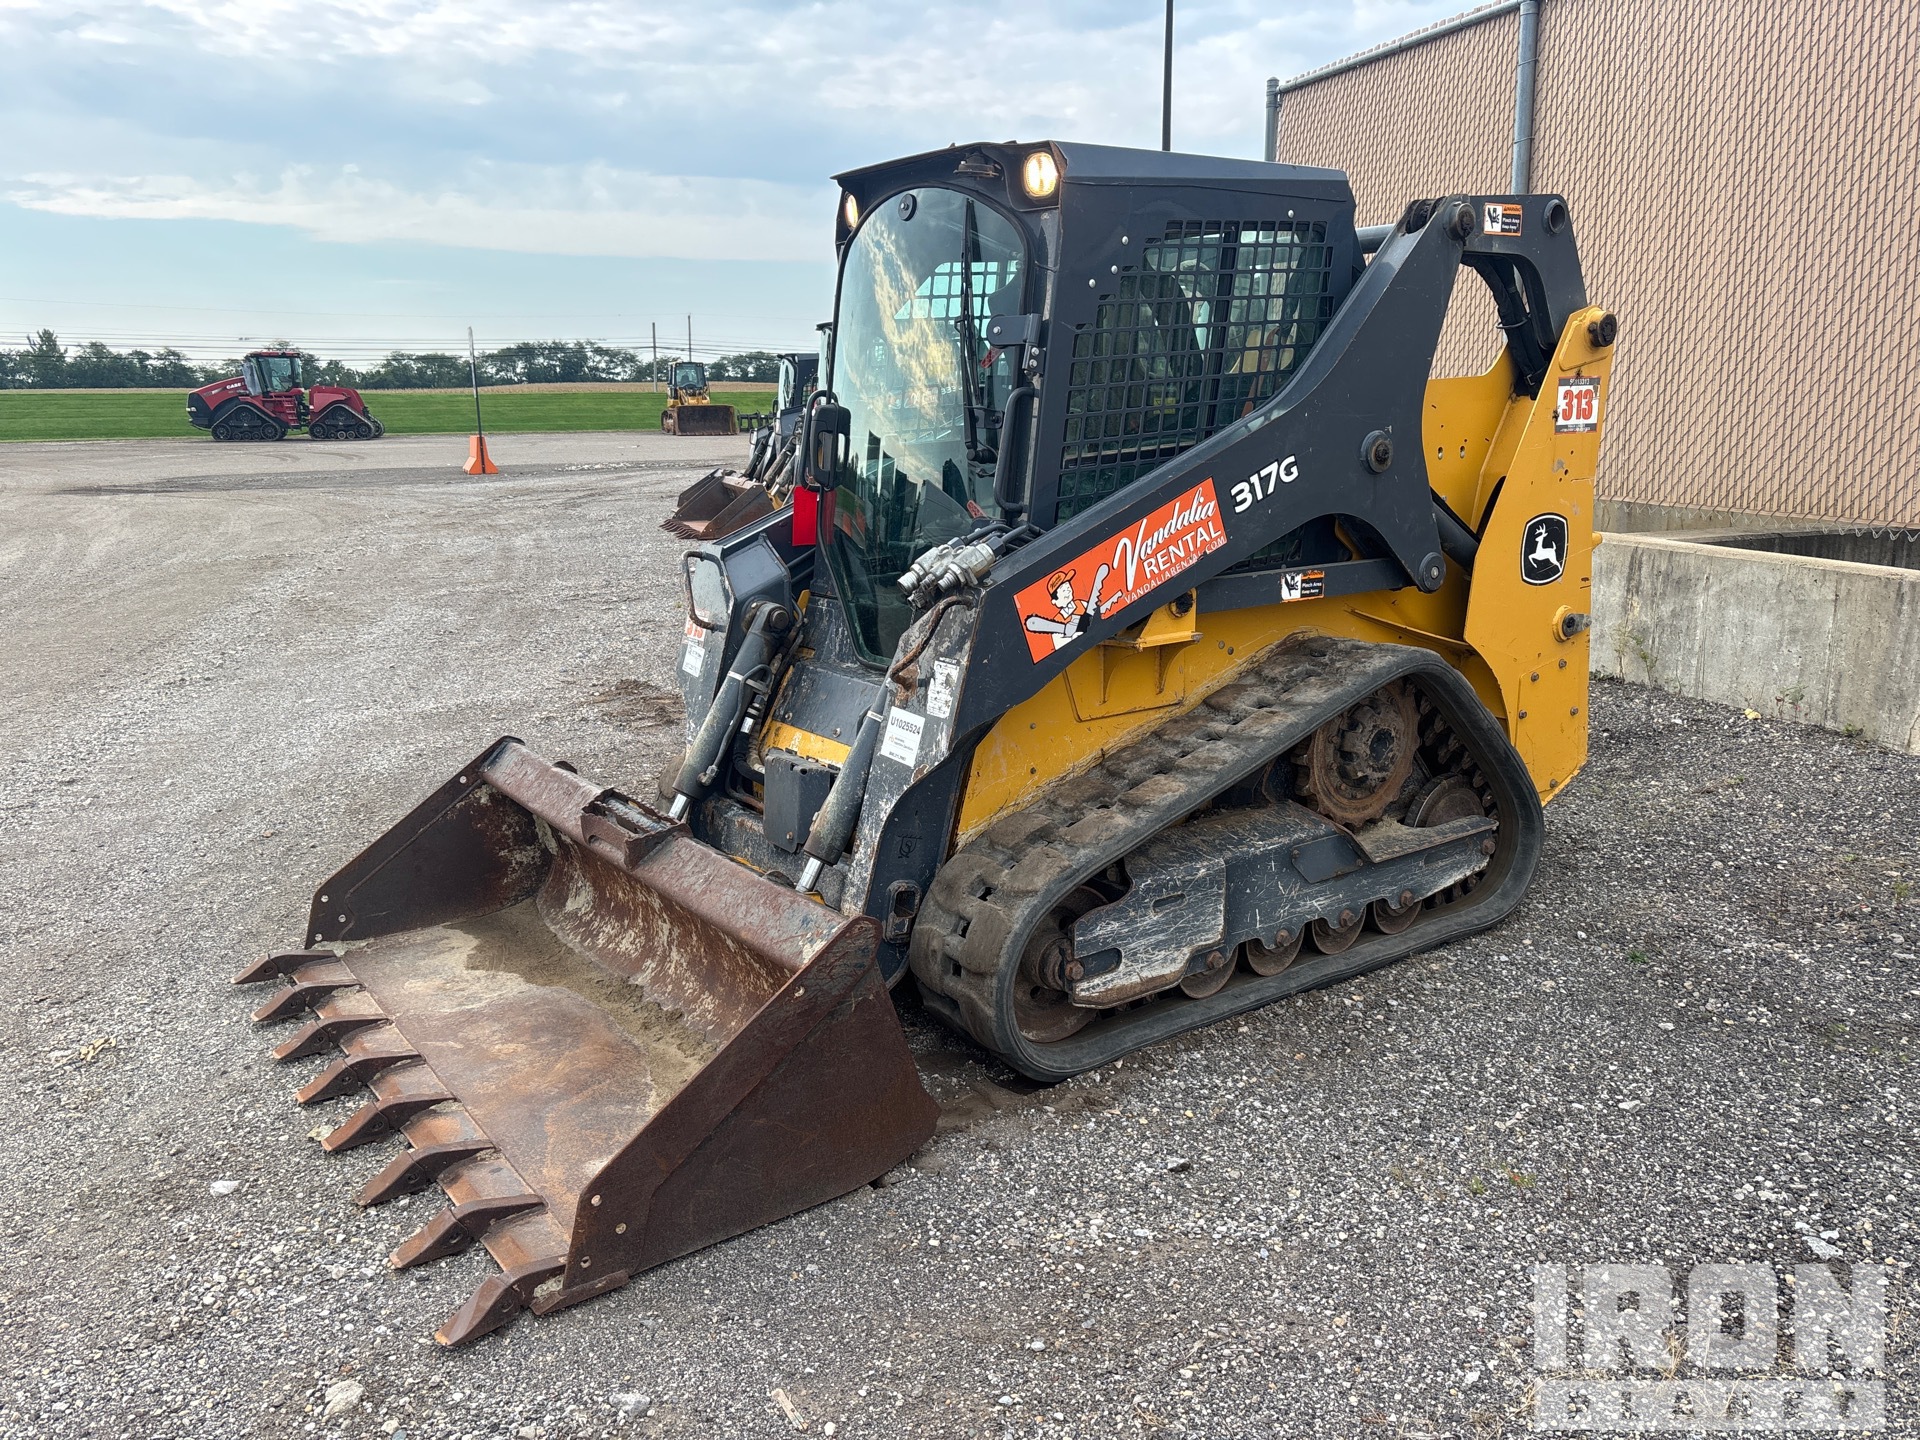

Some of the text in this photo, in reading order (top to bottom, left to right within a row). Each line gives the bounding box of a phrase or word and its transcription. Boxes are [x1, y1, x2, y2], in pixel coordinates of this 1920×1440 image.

[1561, 388, 1594, 421] 313
[1230, 454, 1299, 514] 317G
[1112, 486, 1217, 593] Vandalia
[1142, 519, 1222, 580] RENTAL
[1123, 535, 1226, 605] VANDALIARENTALCOM
[890, 716, 921, 735] U1025524
